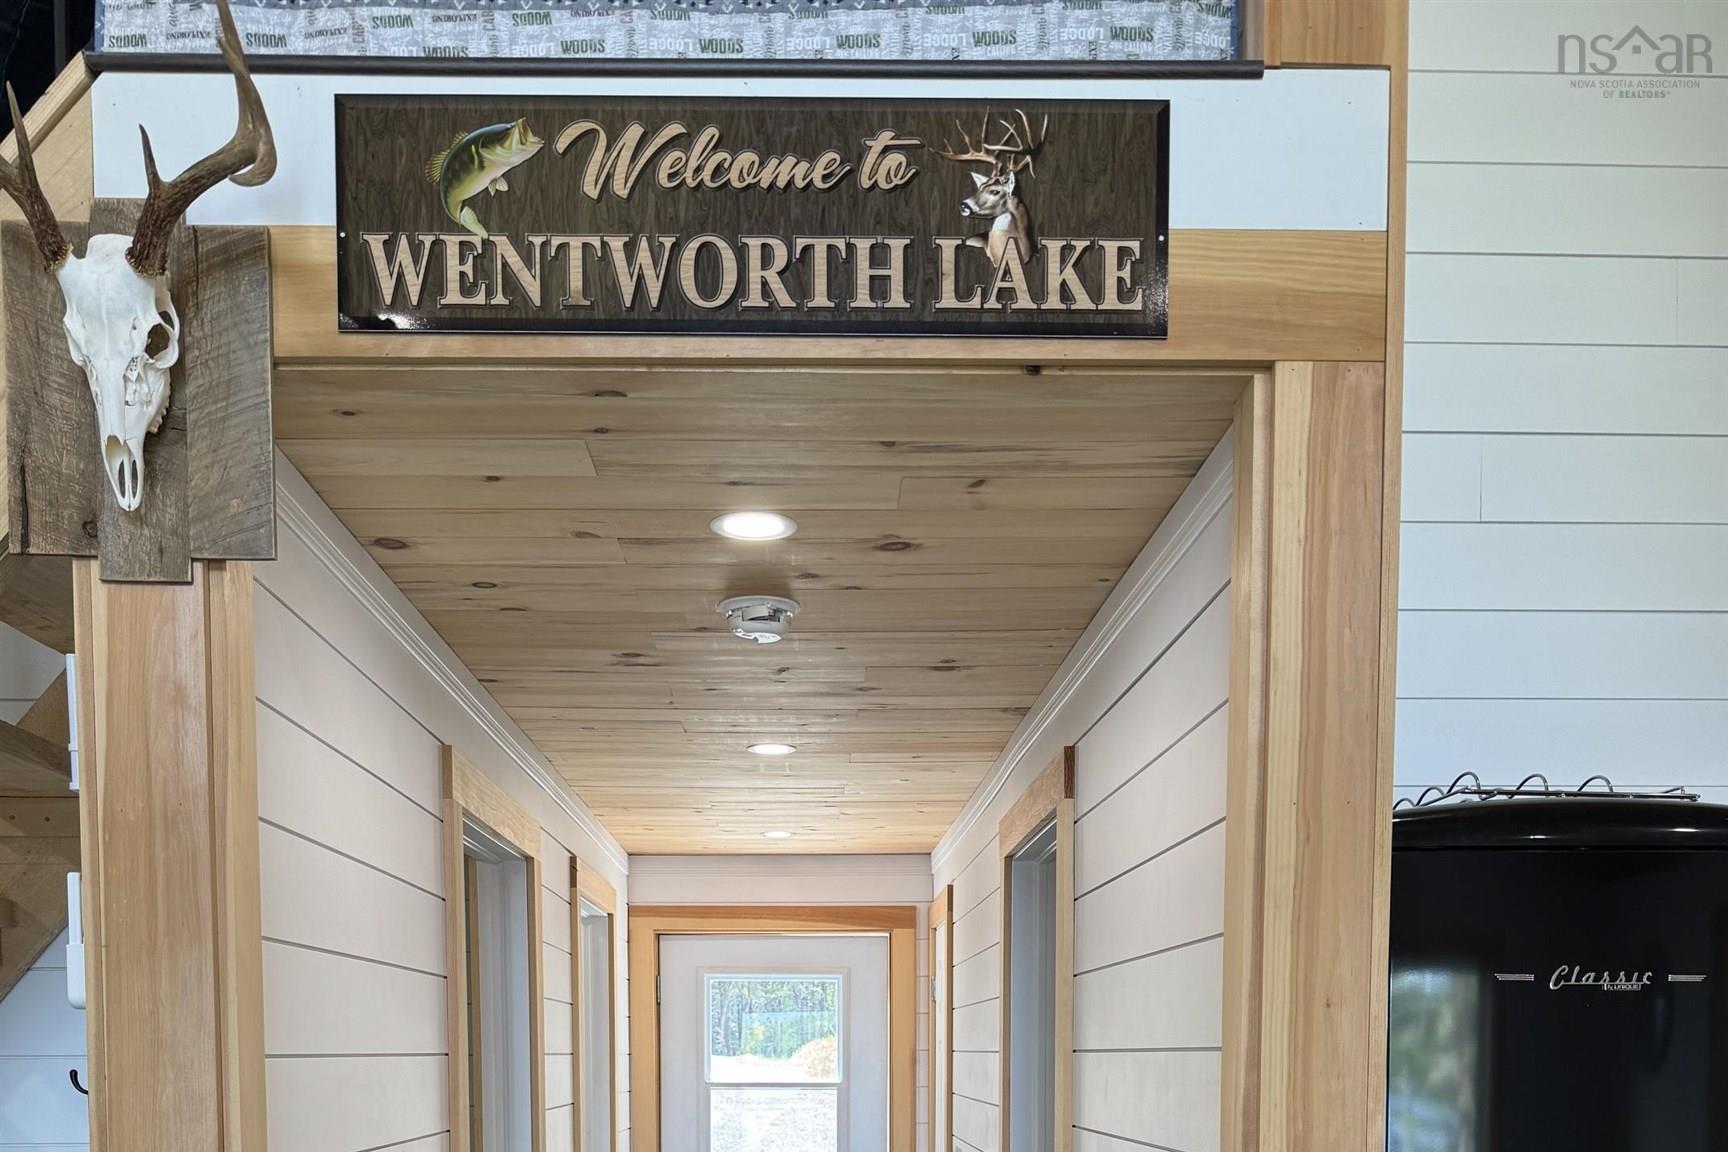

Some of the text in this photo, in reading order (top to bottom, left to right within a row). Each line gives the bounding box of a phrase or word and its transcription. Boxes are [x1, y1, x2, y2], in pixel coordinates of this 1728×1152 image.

[372, 14, 413, 29] WOODS
[512, 11, 552, 27] WOODS
[109, 33, 147, 48] WOODS
[246, 32, 287, 48] WOODS
[836, 33, 880, 49] WOODS
[973, 30, 1016, 47] WOODS
[1110, 26, 1153, 42] WOODS
[561, 39, 605, 55] WOODS
[700, 38, 744, 54] WOODS
[553, 119, 924, 200] Welcome to
[361, 231, 1143, 312] WENTWORTH LAKE
[1550, 965, 1652, 990] Classic
